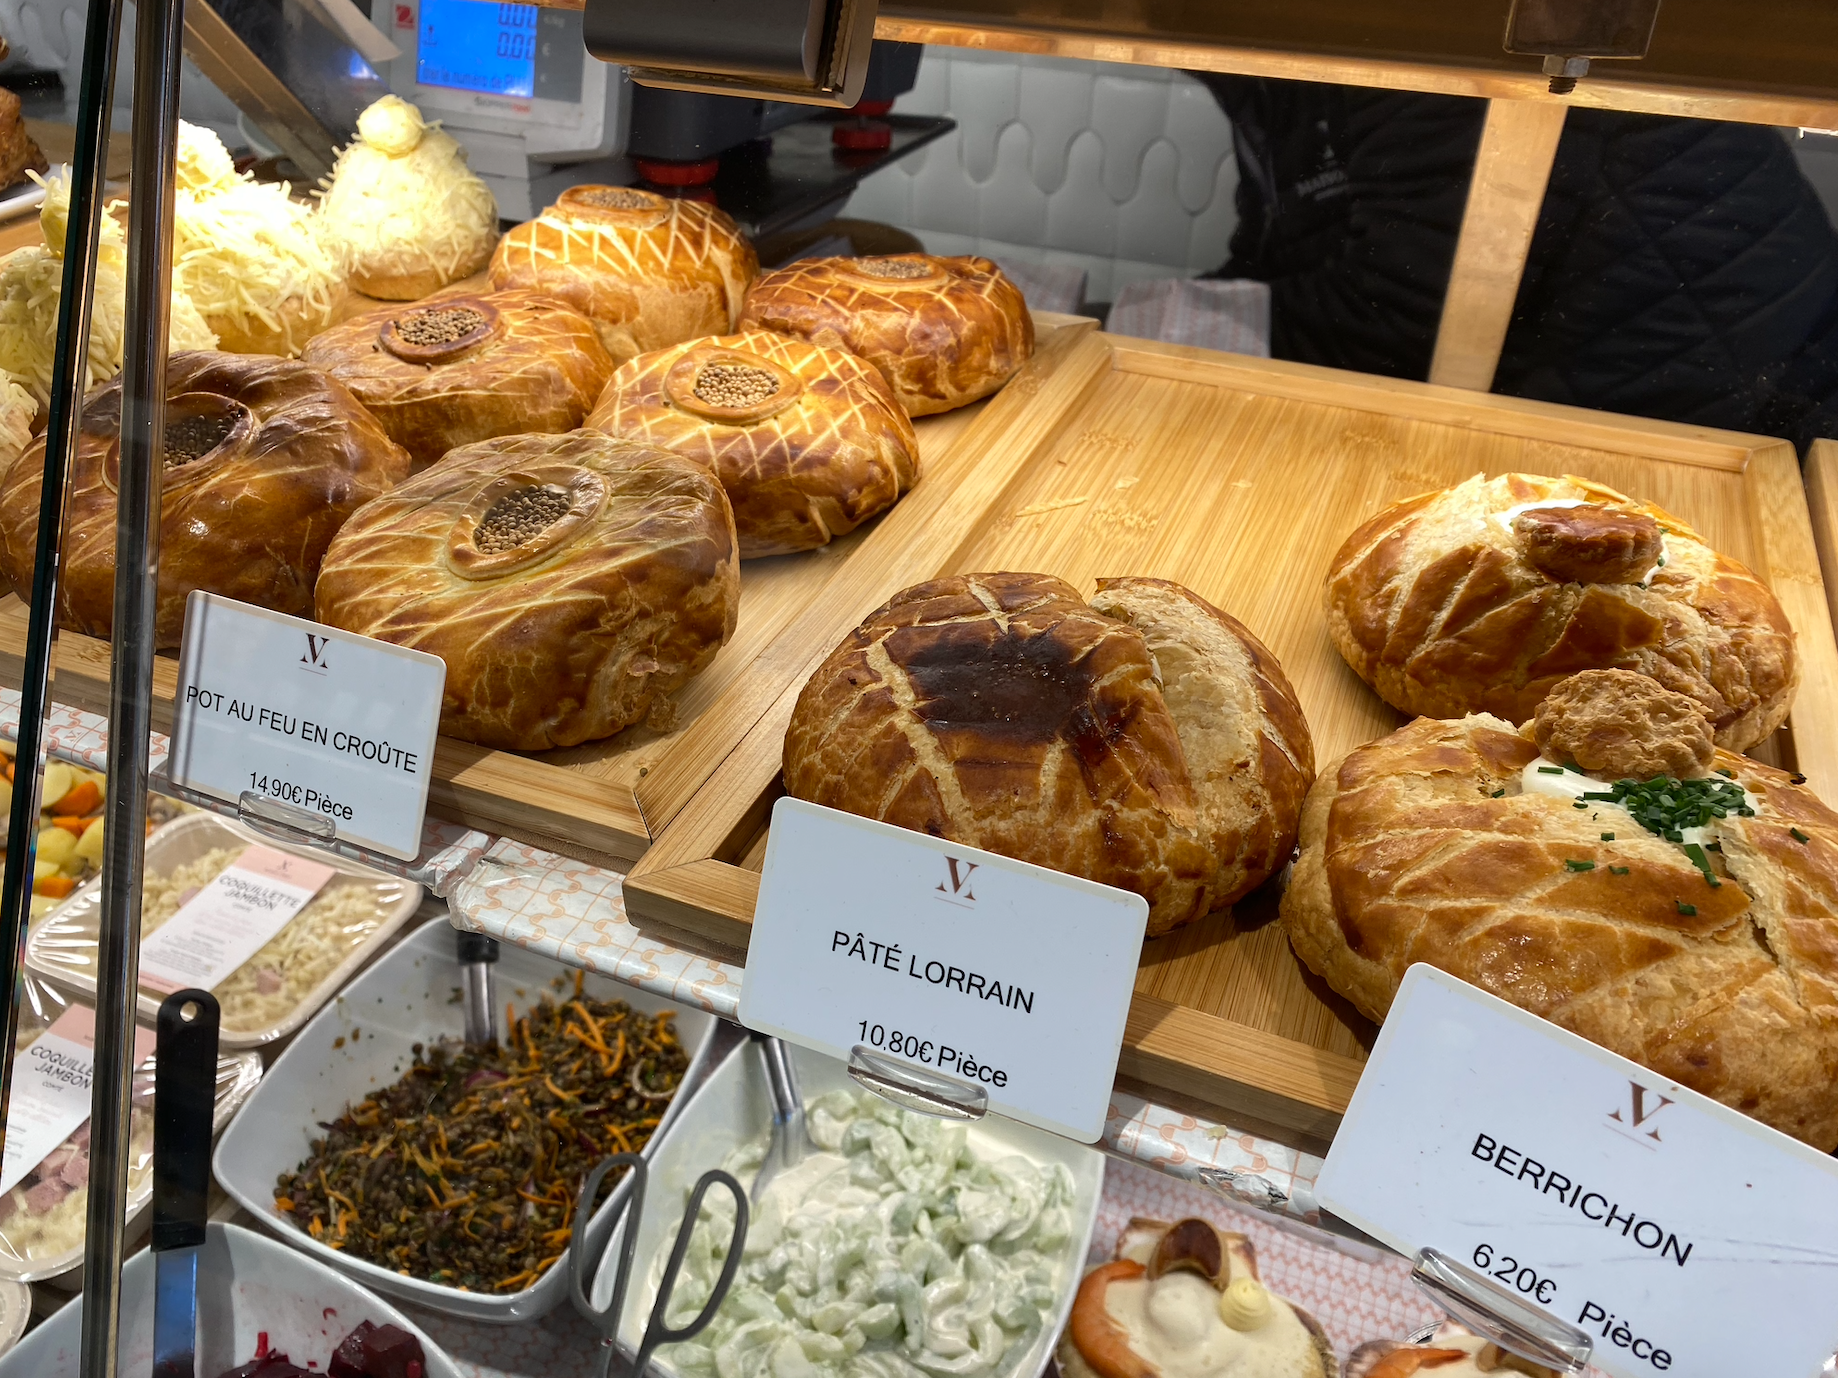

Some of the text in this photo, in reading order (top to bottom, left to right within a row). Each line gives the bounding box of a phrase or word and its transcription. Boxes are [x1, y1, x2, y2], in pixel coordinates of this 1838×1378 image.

[186, 685, 418, 773] POT AU FEU EN CROÛTE
[305, 788, 353, 820] Pièce
[219, 875, 301, 908] COQUILLETTE
[224, 888, 278, 911] JAMBON
[831, 930, 1035, 1013] PÂTÉ LORRAIN
[31, 1046, 93, 1077] COQUILLE
[35, 1063, 92, 1089] JAMBON
[937, 1045, 1008, 1088] Pièce
[1471, 1132, 1694, 1267] BERRICHON
[1472, 1243, 1673, 1371] 6,20€ Pièce
